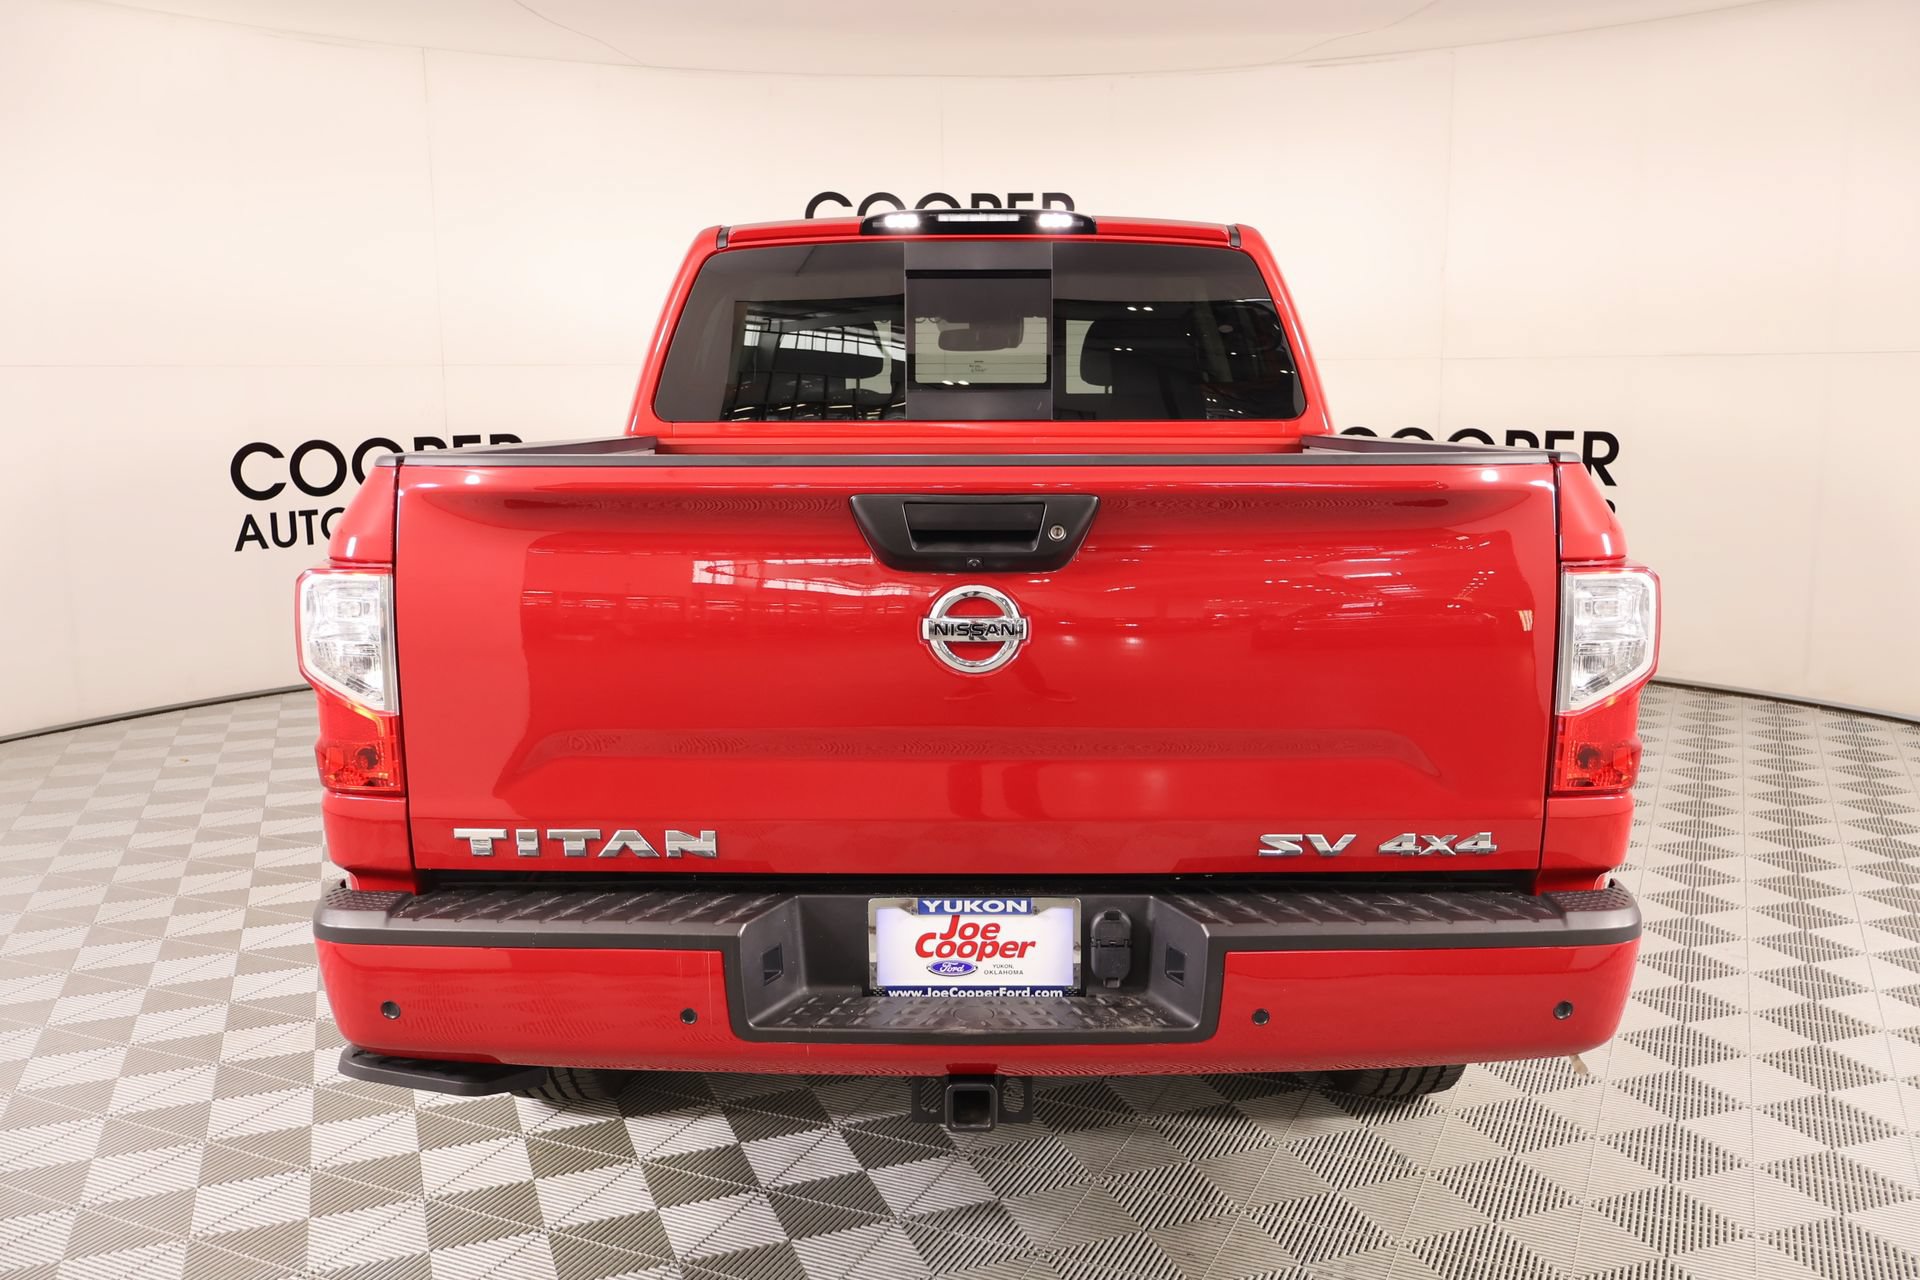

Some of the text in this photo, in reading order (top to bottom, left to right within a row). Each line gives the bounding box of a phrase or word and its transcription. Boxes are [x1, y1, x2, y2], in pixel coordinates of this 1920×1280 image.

[230, 434, 524, 501] COO
[934, 624, 1015, 636] NISSAN
[453, 828, 717, 858] TITAN
[1258, 833, 1357, 857] SV
[922, 900, 1028, 913] YUKON
[938, 914, 1001, 940] Joe
[915, 932, 1036, 961] Cooper
[939, 962, 965, 973] Ford
[888, 987, 1064, 998] www.JoeCooperFord.com
